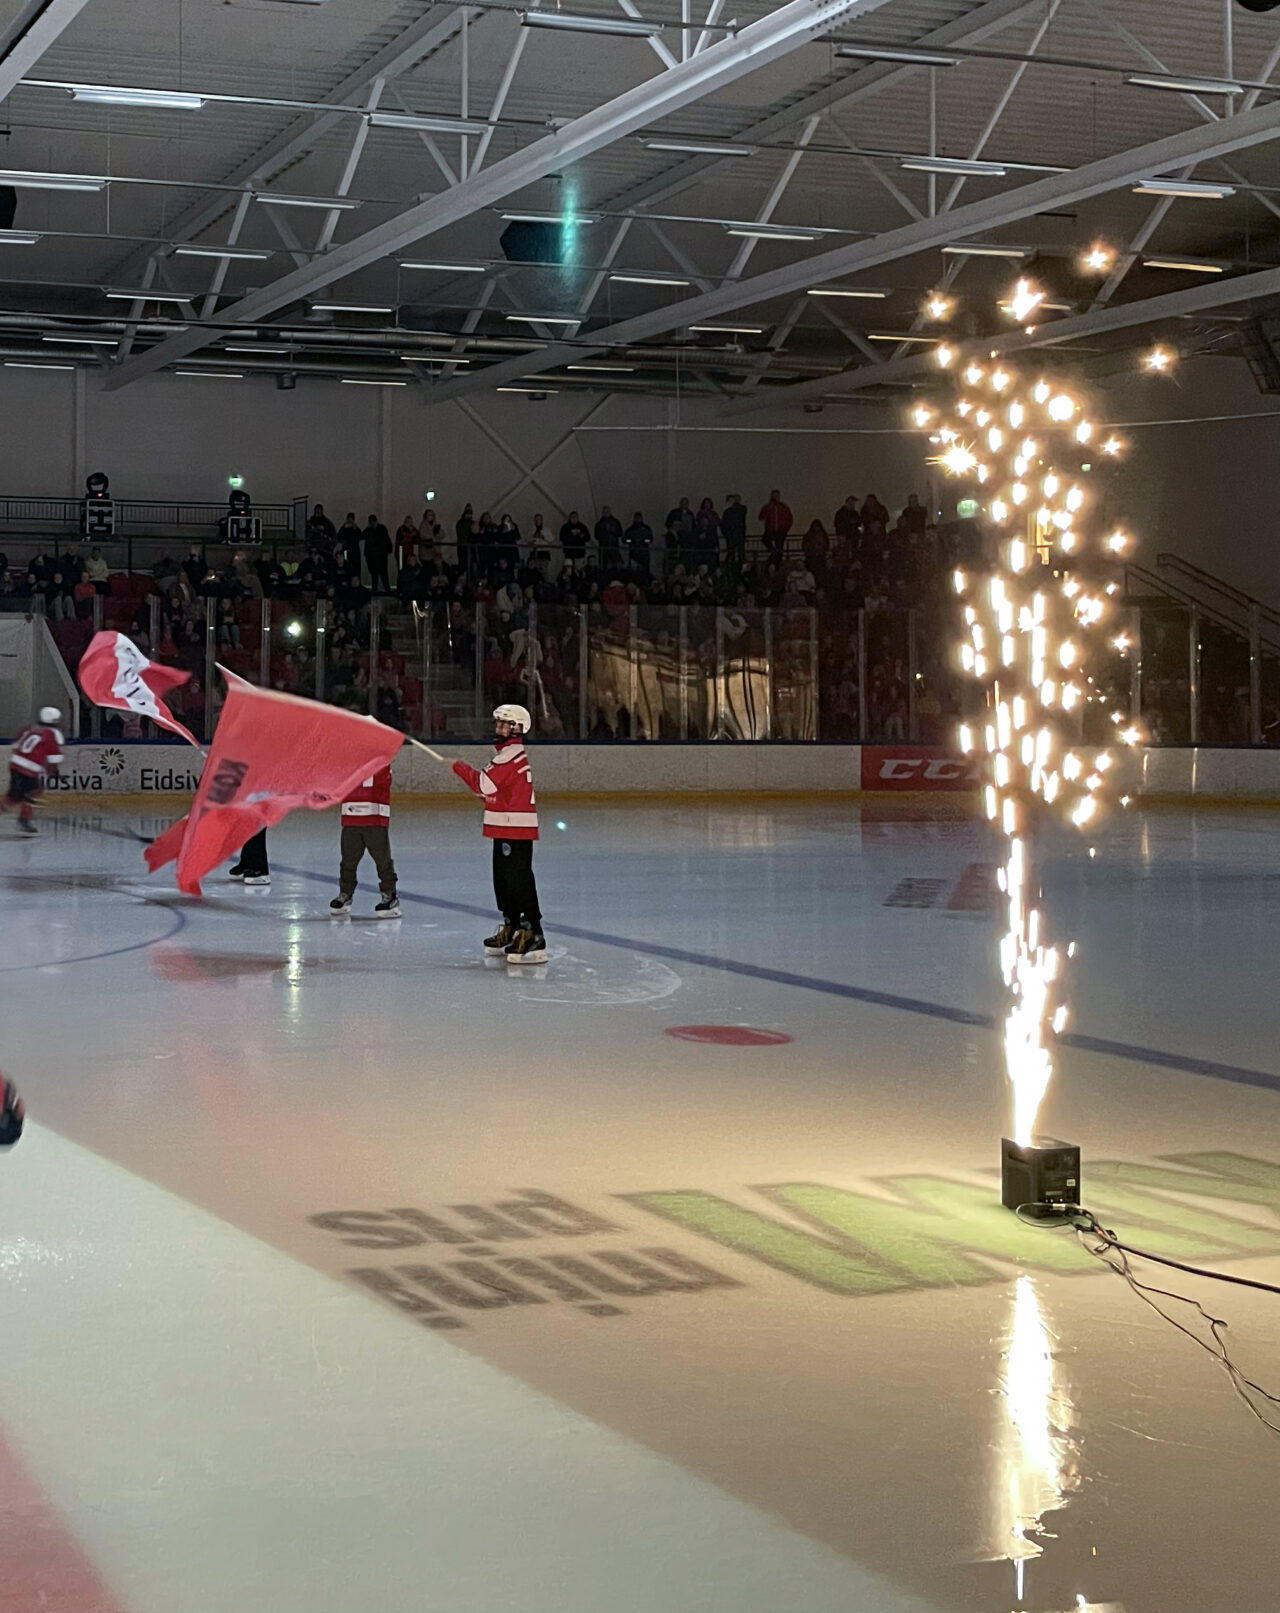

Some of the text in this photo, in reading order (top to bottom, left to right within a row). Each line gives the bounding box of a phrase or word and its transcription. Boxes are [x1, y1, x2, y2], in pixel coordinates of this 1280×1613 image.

[40, 769, 103, 791] idsiva
[141, 768, 201, 791] Eidsiv
[309, 1187, 628, 1251] pris
[344, 1247, 747, 1331] mini
